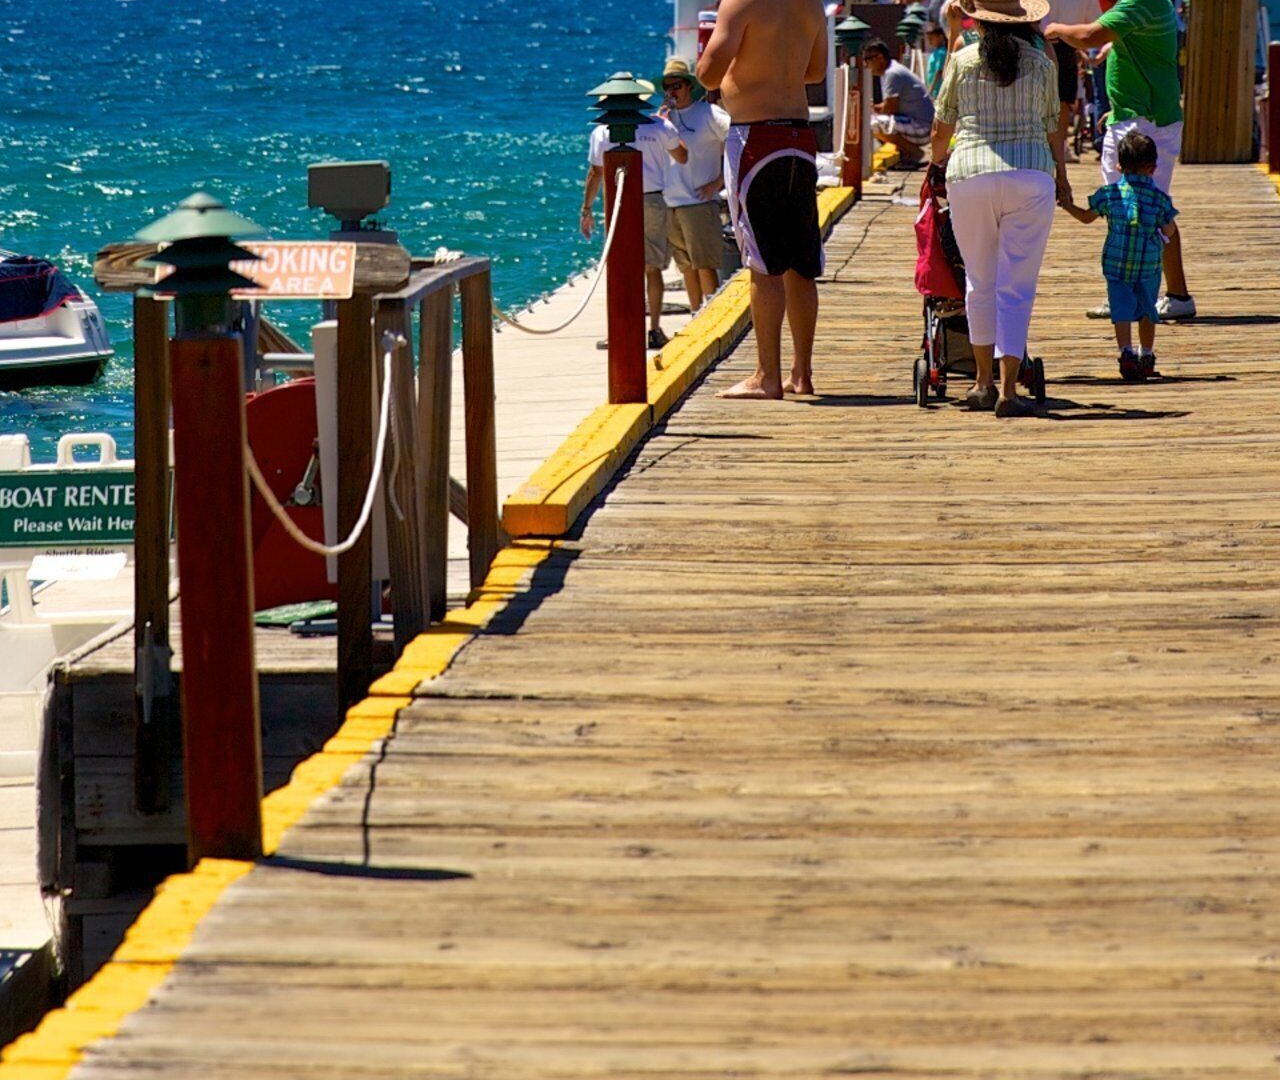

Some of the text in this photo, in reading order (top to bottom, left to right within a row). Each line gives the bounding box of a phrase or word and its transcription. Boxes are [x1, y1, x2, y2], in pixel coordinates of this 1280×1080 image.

[269, 276, 335, 294] AREA
[64, 484, 135, 508] RENTE
[13, 515, 135, 533] Please Wait Her
